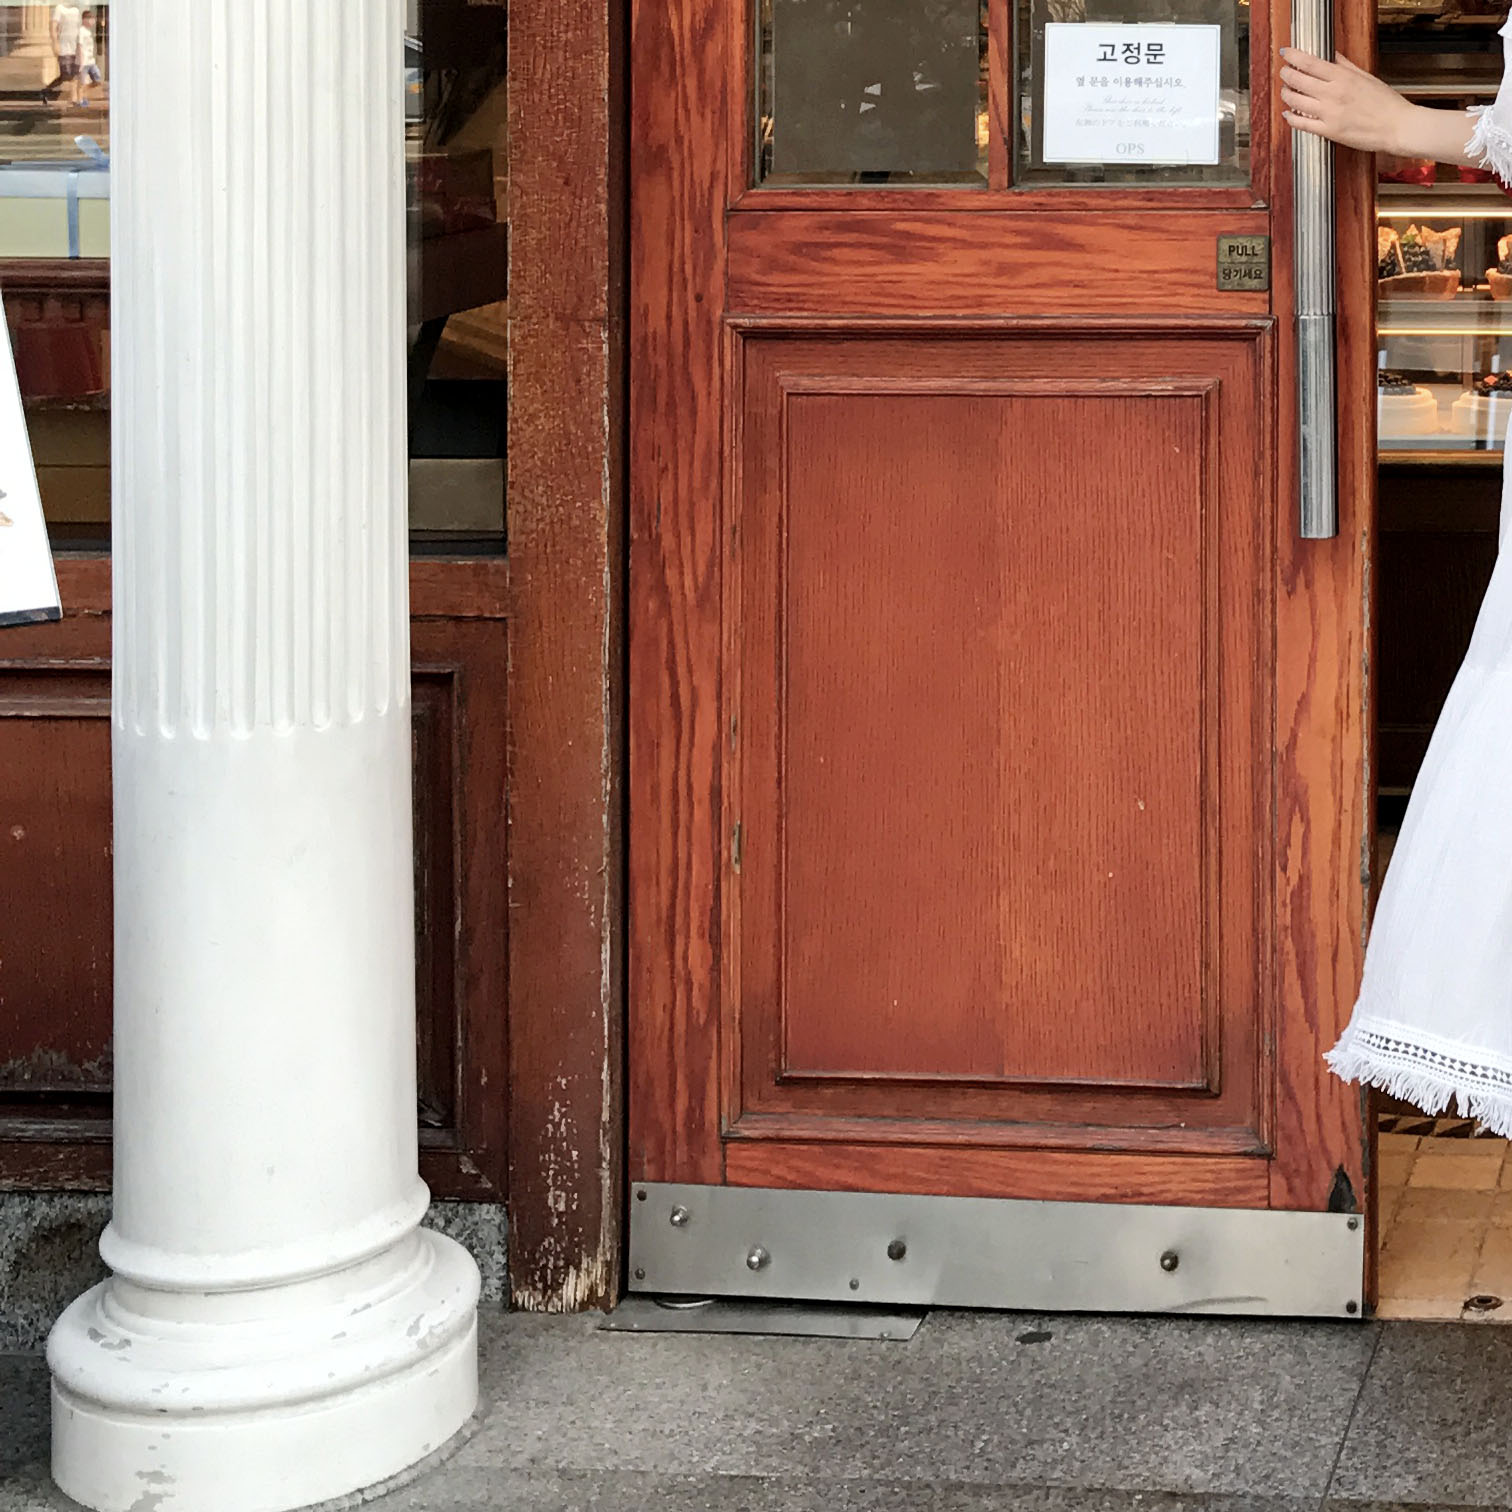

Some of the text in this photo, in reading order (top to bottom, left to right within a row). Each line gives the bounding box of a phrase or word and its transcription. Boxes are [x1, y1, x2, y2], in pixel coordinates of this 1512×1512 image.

[1096, 42, 1166, 65] 고정문
[1115, 142, 1145, 155] OPS
[1228, 244, 1259, 257] PULL
[1222, 268, 1264, 281] 당기세요
